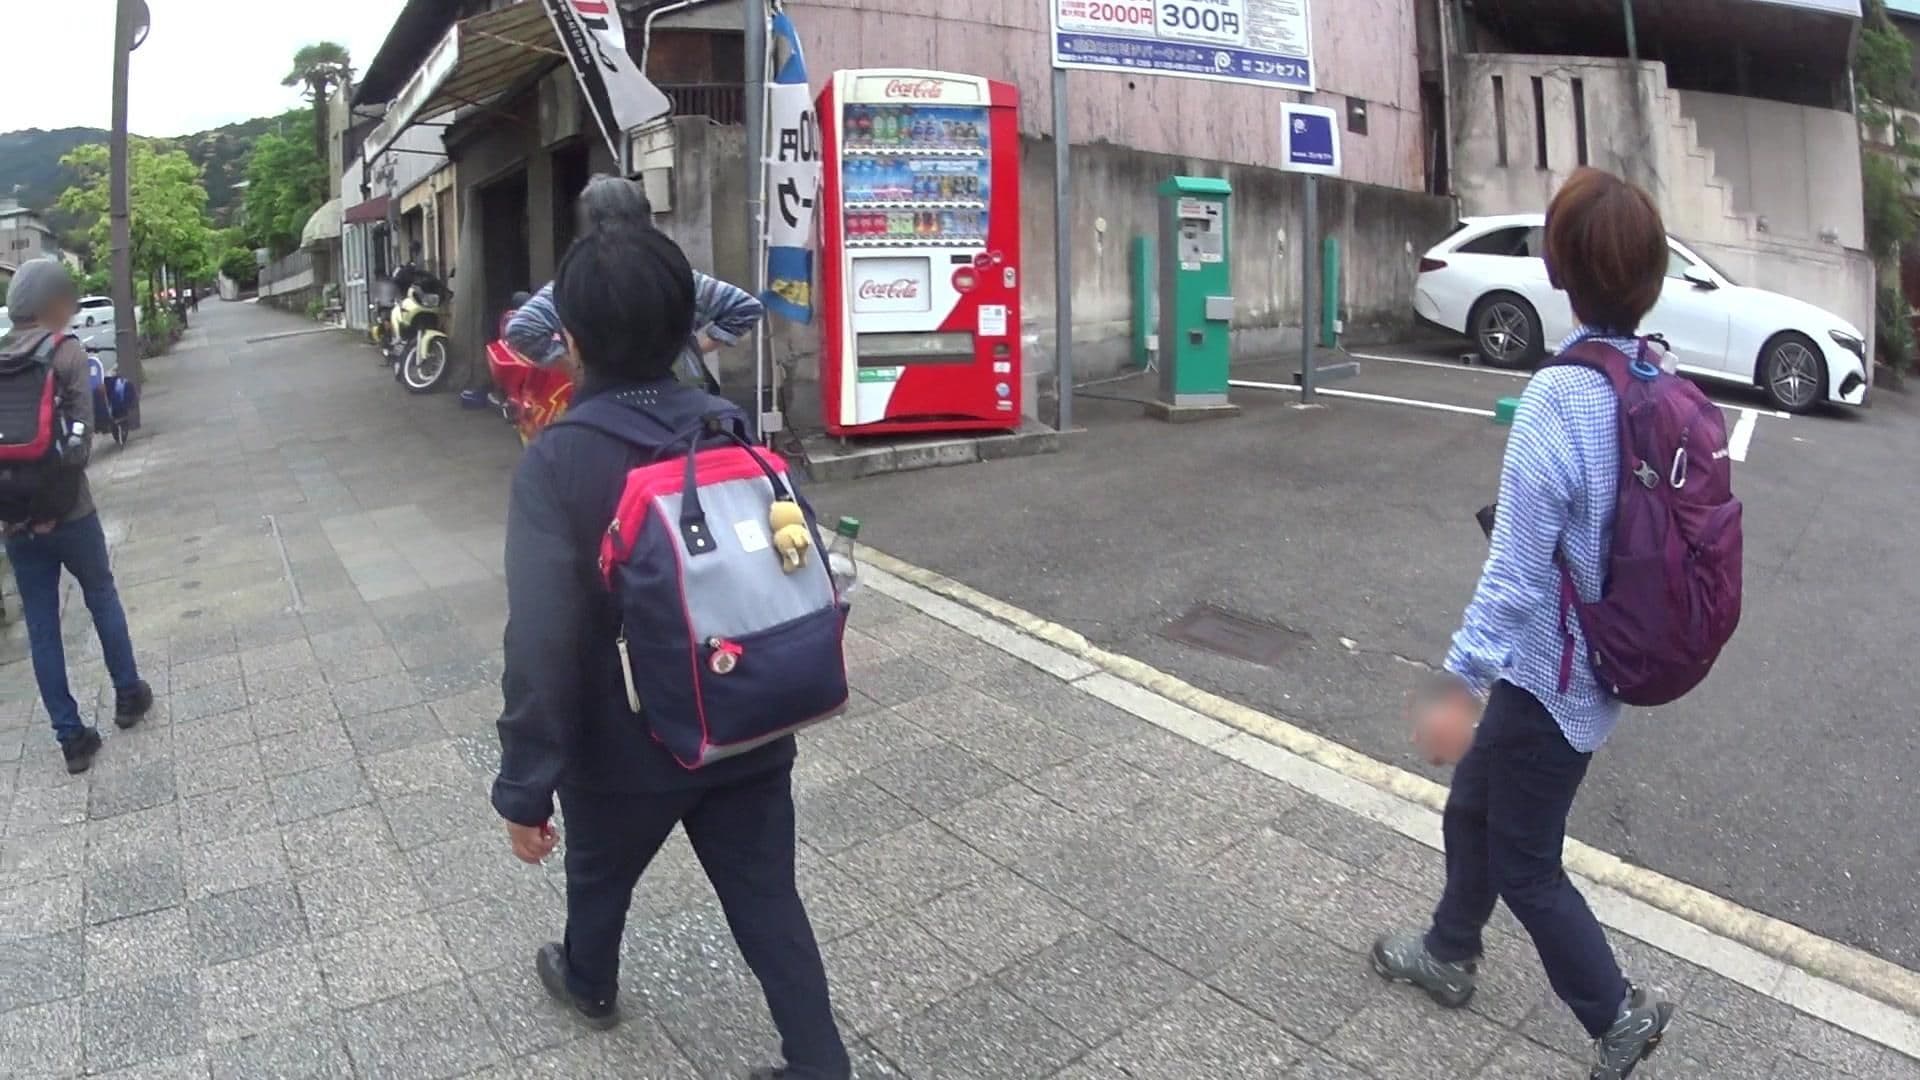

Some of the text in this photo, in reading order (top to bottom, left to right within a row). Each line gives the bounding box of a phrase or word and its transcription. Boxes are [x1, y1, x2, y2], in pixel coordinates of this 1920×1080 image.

[1088, 2, 1153, 25] 2000円
[1162, 4, 1239, 35] 300円
[1253, 60, 1306, 79] コンセプト
[859, 278, 920, 300] Coca-Cola
